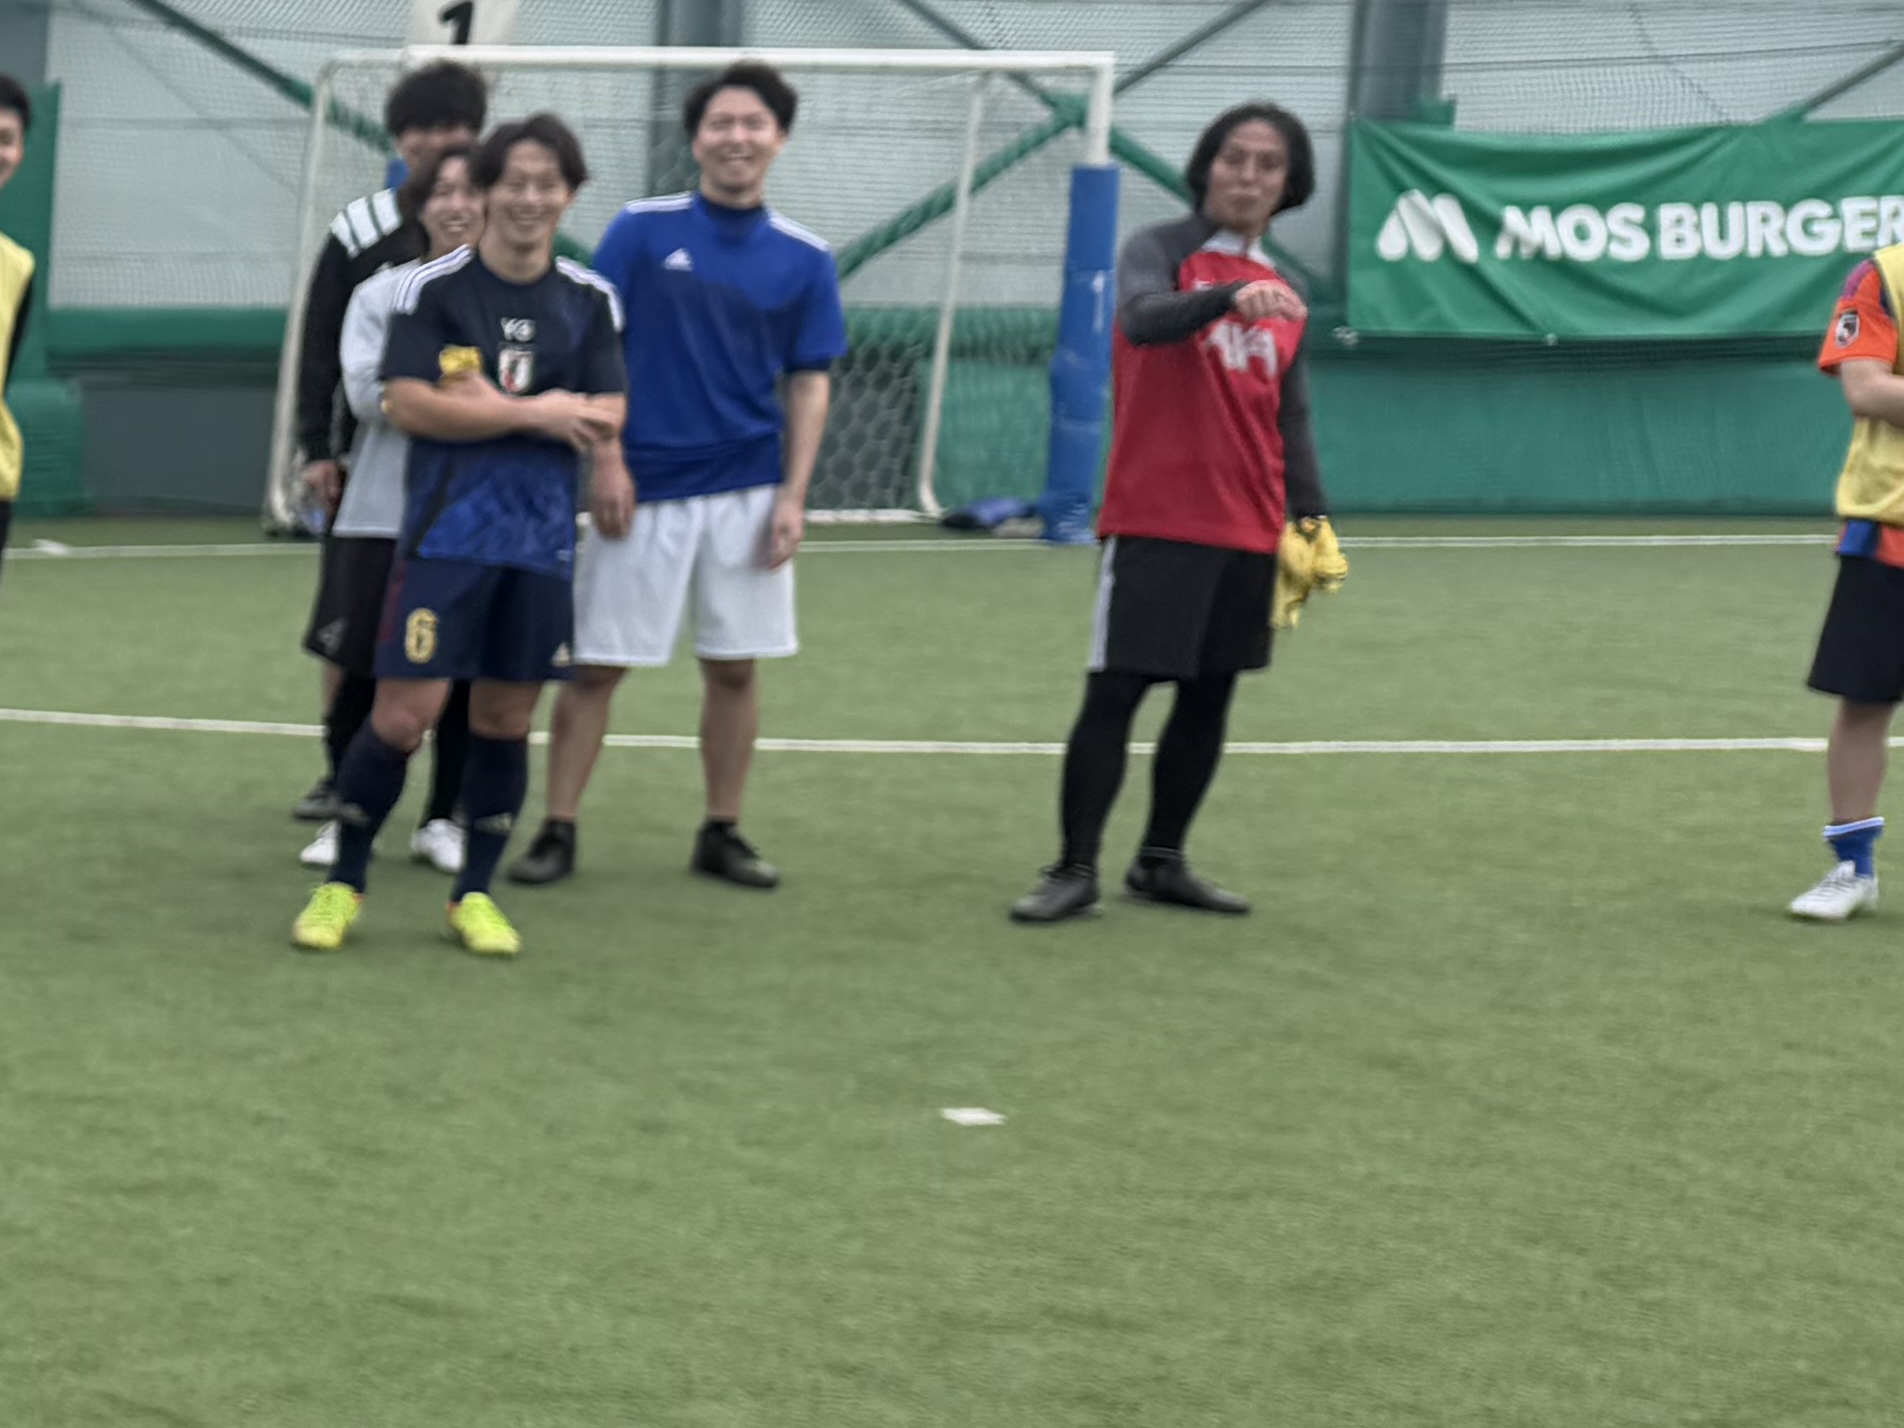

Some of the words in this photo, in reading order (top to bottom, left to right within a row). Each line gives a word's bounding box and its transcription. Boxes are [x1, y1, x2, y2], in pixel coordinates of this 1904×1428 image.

[1496, 203, 1650, 262] MOS
[1658, 196, 1904, 260] BURGER
[405, 608, 438, 664] 6
